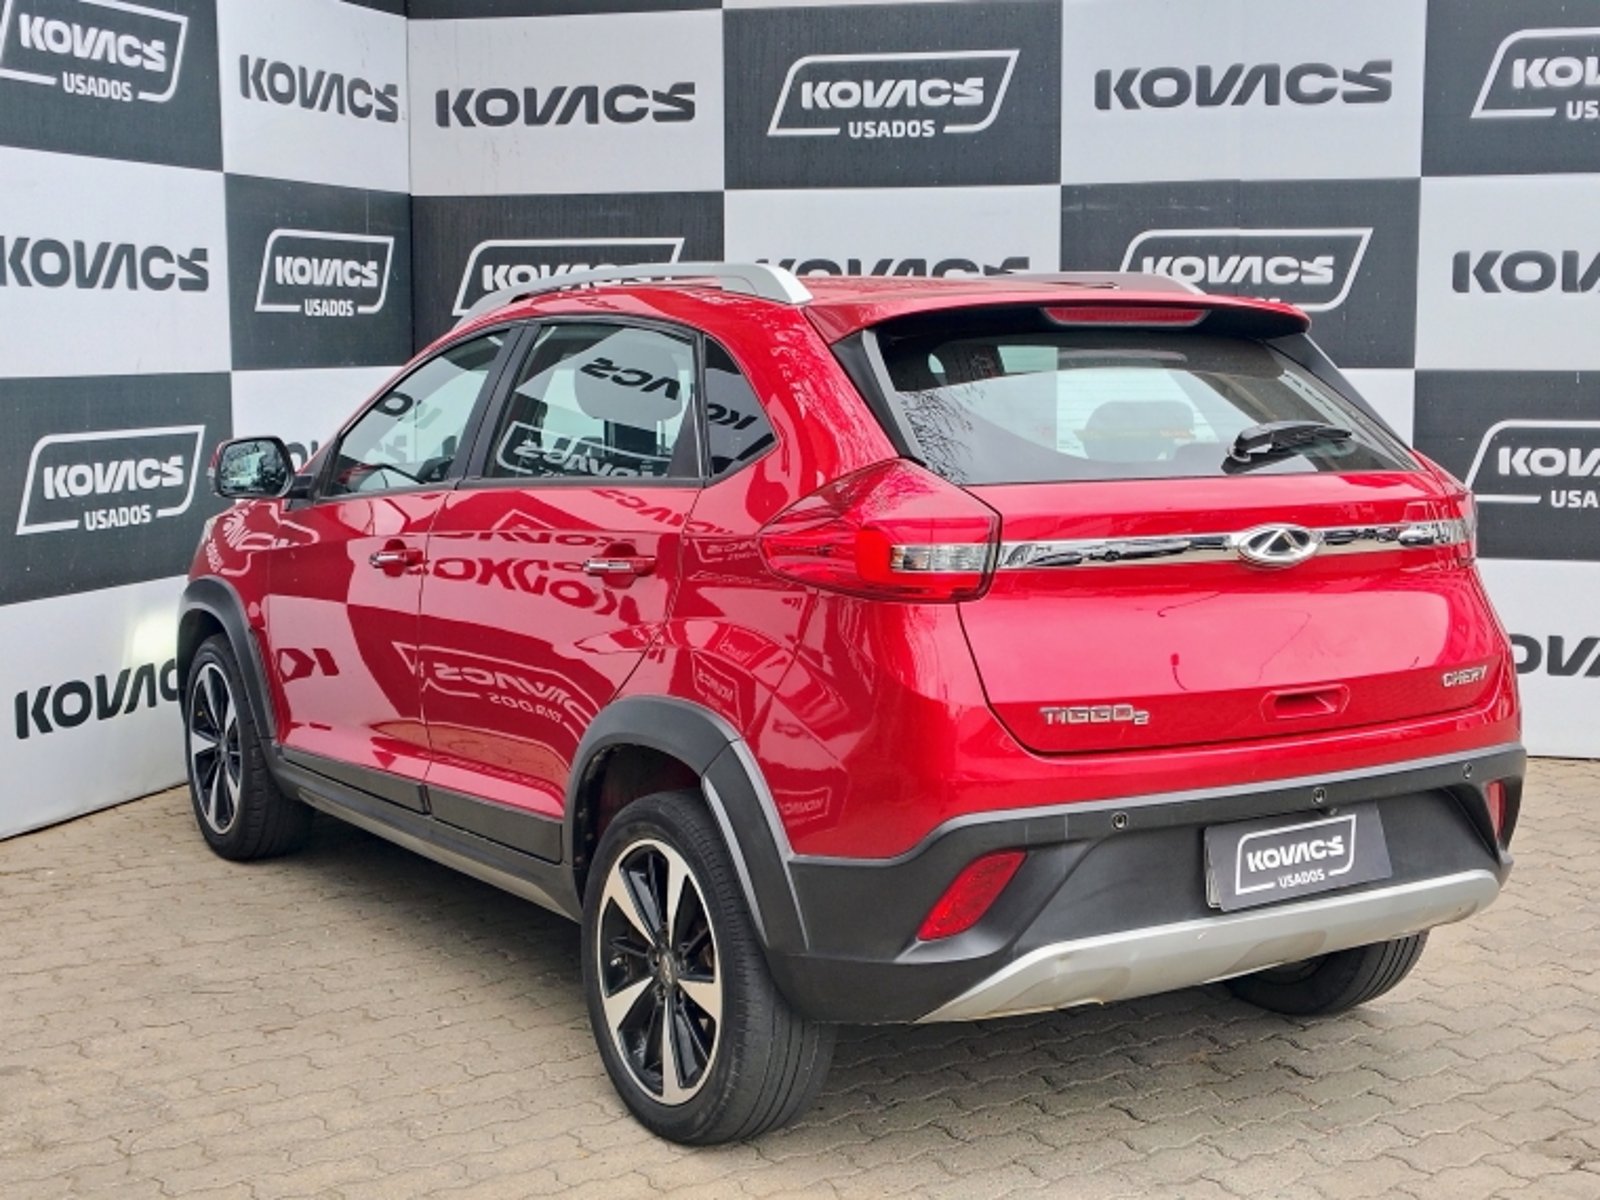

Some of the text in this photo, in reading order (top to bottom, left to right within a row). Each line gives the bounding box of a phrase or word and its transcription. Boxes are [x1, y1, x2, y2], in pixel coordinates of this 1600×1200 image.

[19, 13, 167, 73] KOVACS
[62, 71, 133, 102] USADOS
[239, 54, 399, 124] KOVACS
[801, 77, 984, 109] KOVACS
[1094, 60, 1393, 111] KOVACS
[435, 81, 696, 128] KOVACS
[1566, 100, 1600, 121] US
[848, 119, 936, 139] USADOS
[0, 235, 209, 292] KOVACS
[275, 256, 378, 288] KOVACS
[1143, 255, 1335, 285] KOVACS
[1451, 250, 1600, 293] KOV
[304, 298, 355, 317] USADOS
[43, 455, 184, 500] KOVACS
[1498, 447, 1600, 477] KOV
[84, 504, 152, 532] USADOS
[1507, 634, 1600, 677] OV
[1443, 665, 1487, 687] CHERY
[15, 658, 178, 740] KOVAC
[1246, 834, 1345, 872] KOVACS
[1277, 868, 1326, 889] USADOS
